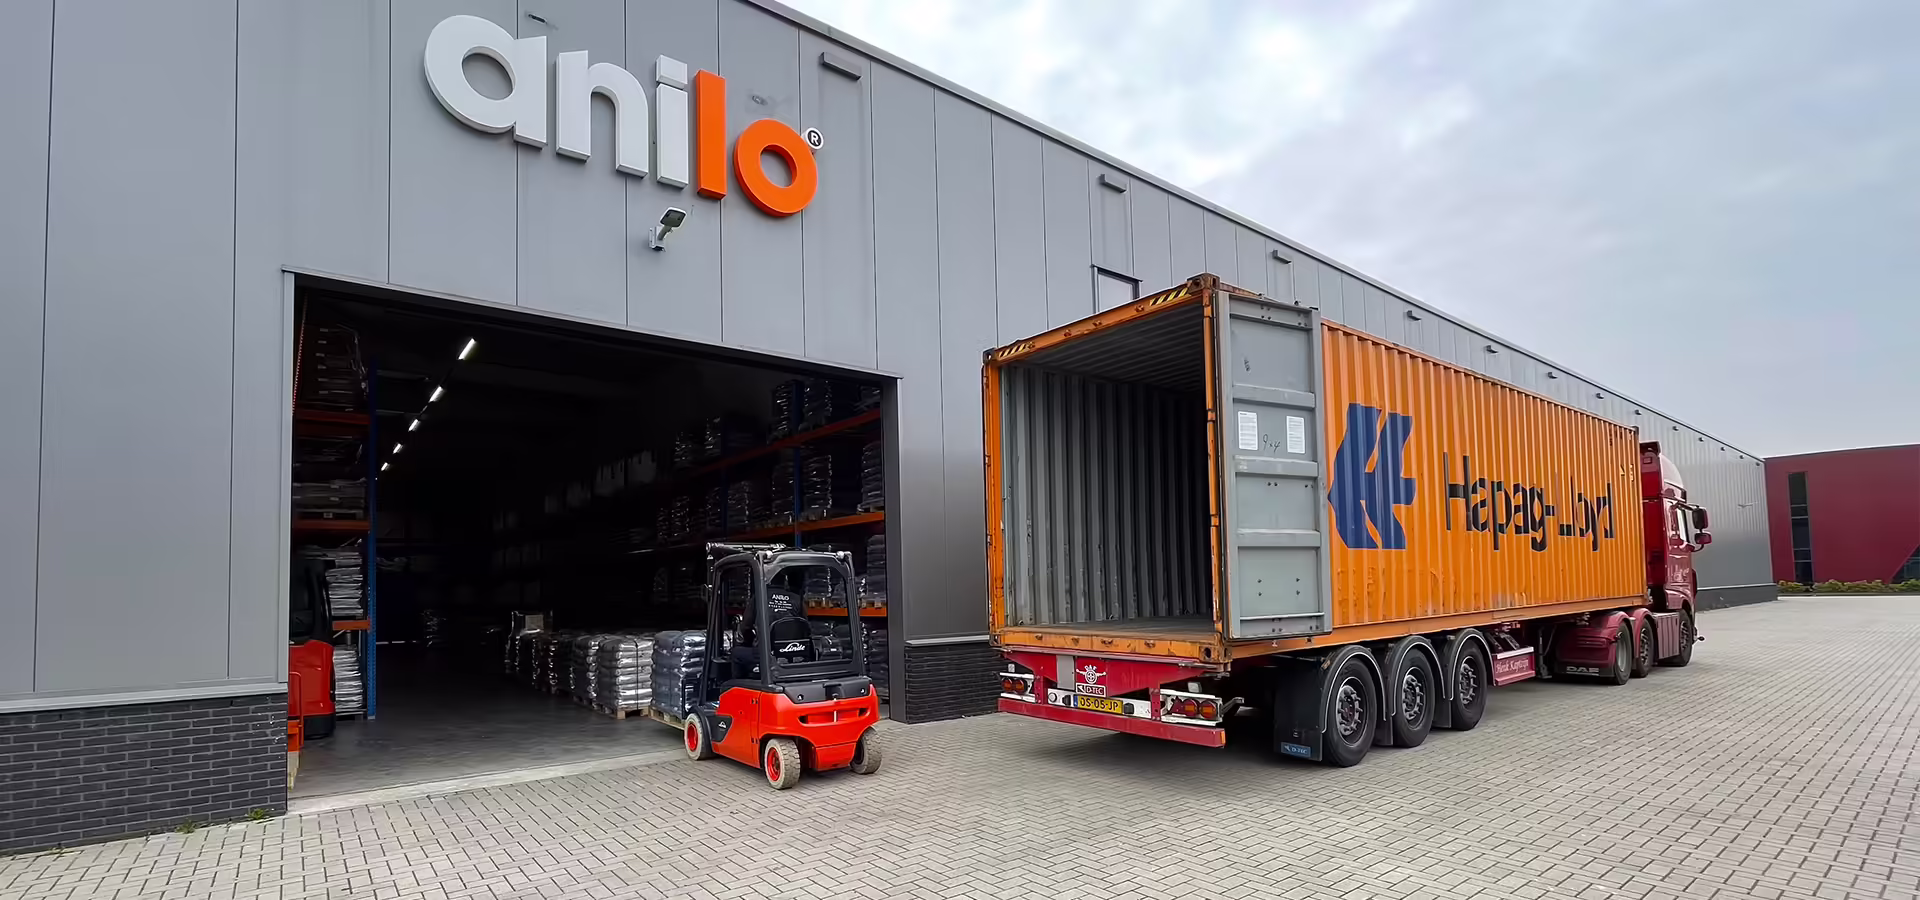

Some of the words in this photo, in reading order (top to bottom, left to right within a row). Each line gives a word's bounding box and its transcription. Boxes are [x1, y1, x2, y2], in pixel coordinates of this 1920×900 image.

[423, 14, 818, 217] anilo
[779, 642, 806, 653] Linde
[1086, 686, 1104, 695] D-TEC
